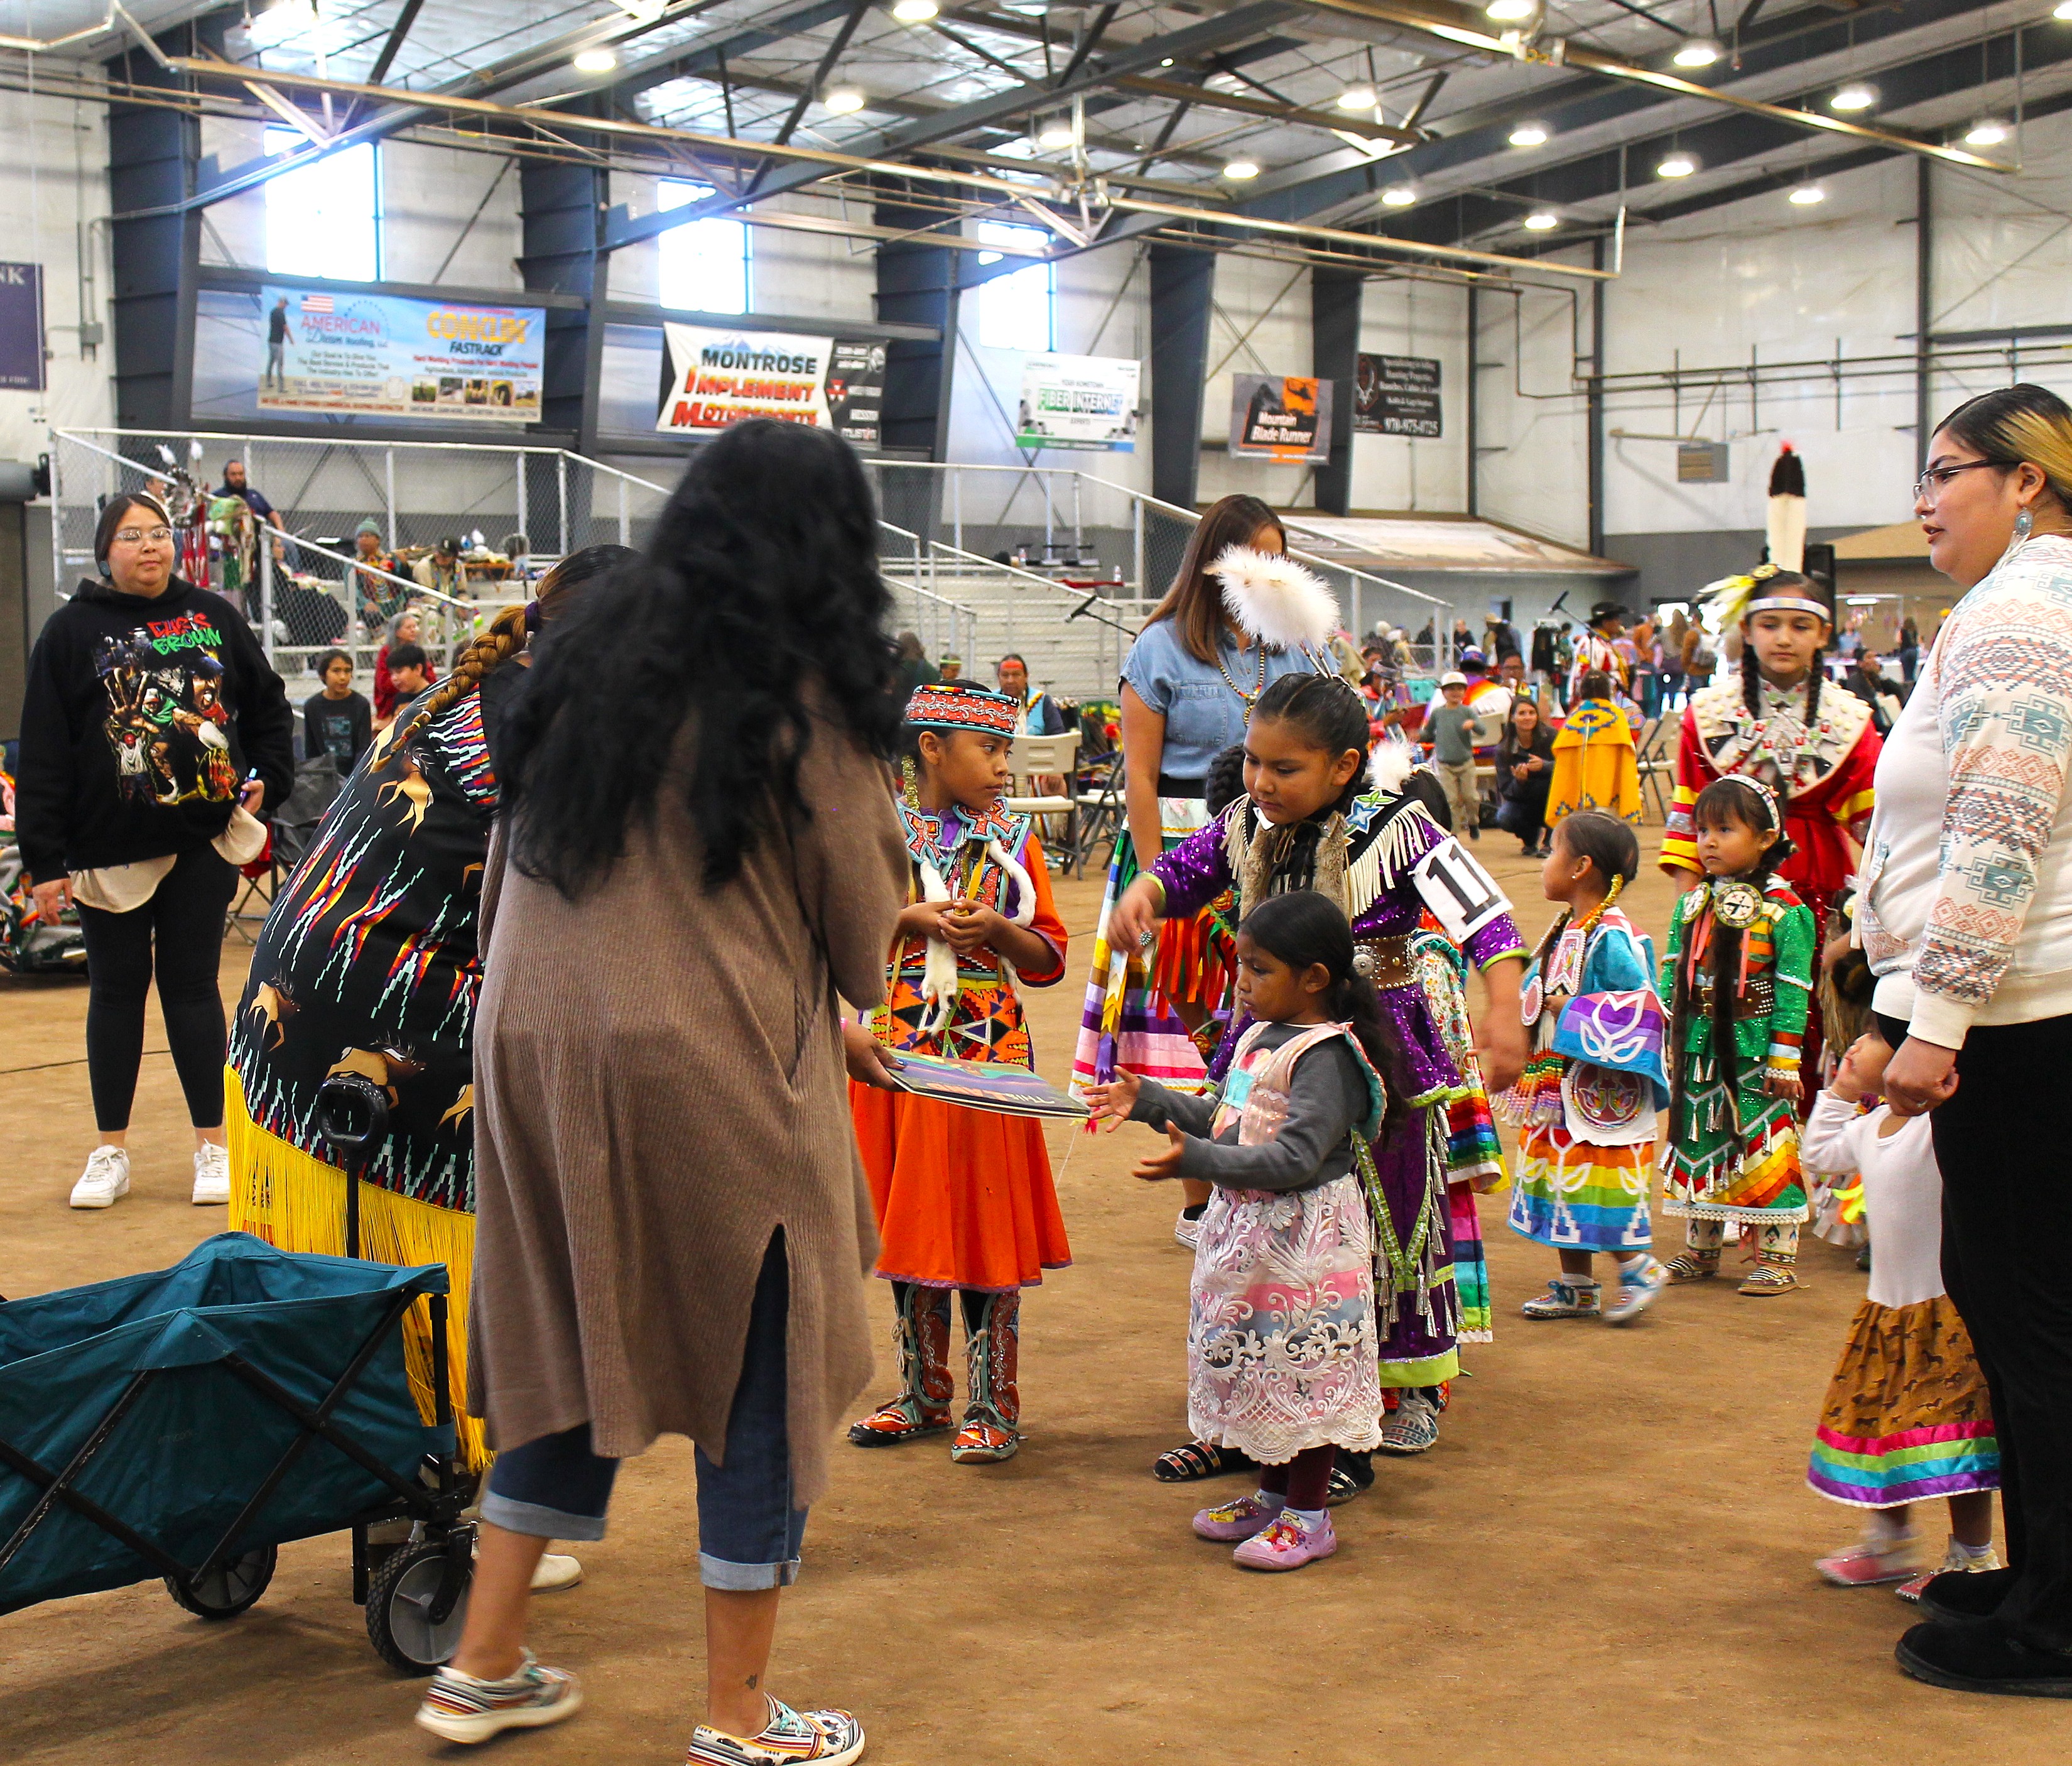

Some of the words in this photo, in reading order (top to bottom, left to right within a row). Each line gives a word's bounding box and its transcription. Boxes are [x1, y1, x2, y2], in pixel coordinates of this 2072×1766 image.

[301, 315, 380, 334] AMERICAN
[449, 341, 504, 355] FASTRACK
[702, 348, 817, 374] MONTROSE
[684, 366, 816, 401] IMPLEMENT
[1038, 388, 1070, 412] FIBER
[1072, 390, 1123, 415] INTERNET
[1257, 411, 1297, 427] Mountain
[1250, 425, 1278, 442] Blade
[1279, 427, 1313, 444] Runner
[151, 628, 222, 655] BROWN
[1426, 844, 1502, 925] 11
